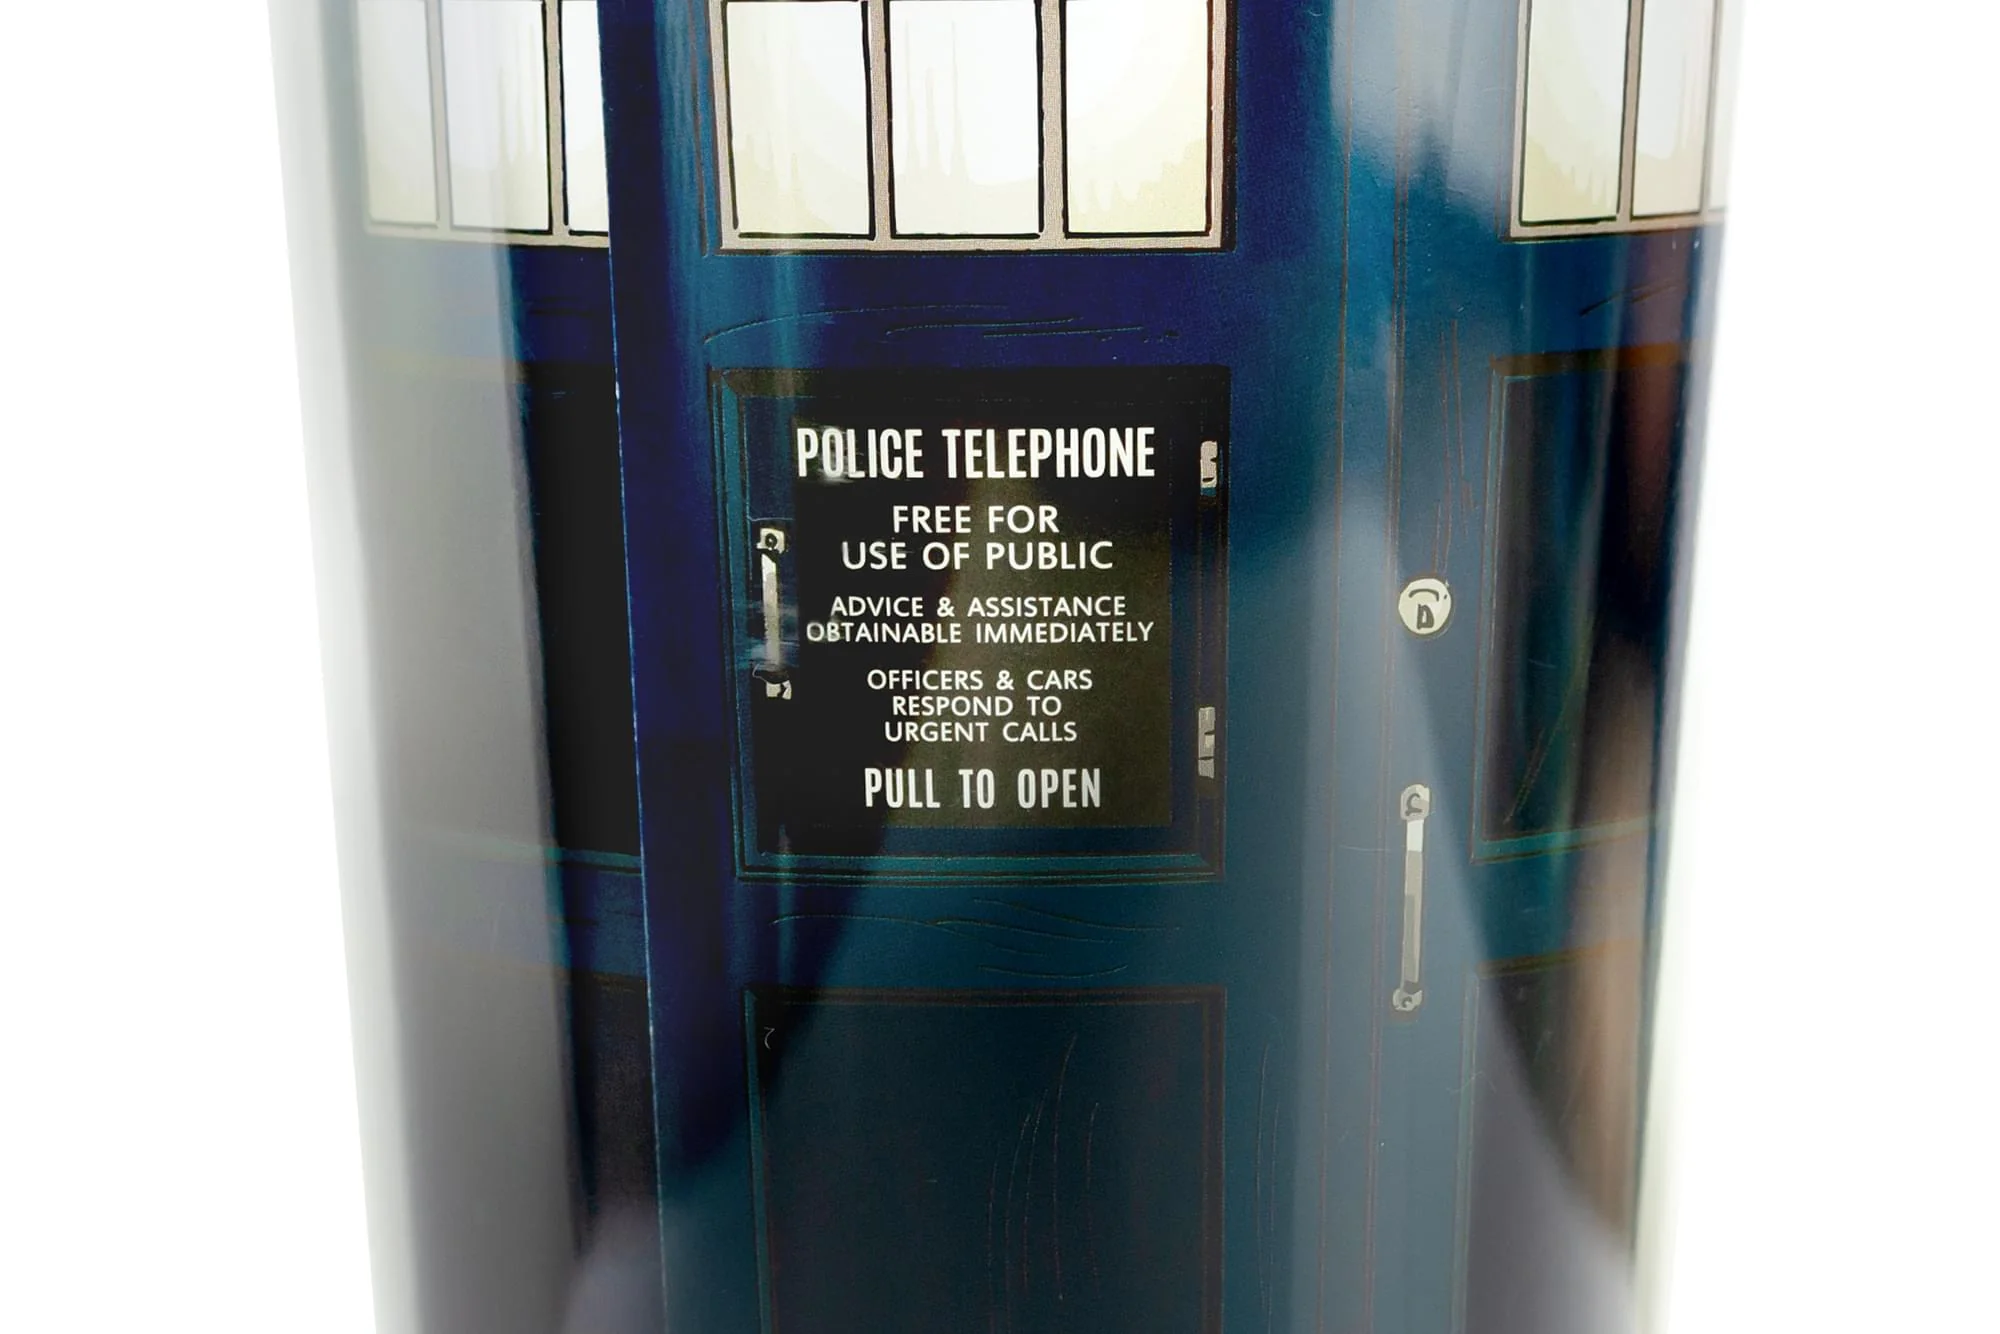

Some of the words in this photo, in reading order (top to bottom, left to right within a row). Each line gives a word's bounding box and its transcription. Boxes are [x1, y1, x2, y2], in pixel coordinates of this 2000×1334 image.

[796, 426, 924, 479] POLICE
[941, 426, 1155, 479] TELEPHONE
[892, 505, 972, 534] FREE
[987, 504, 1060, 534] FOR
[842, 541, 907, 570] USE
[922, 541, 970, 571] OF
[985, 540, 1113, 571] PUBLIC
[830, 595, 924, 618] ADVICE
[936, 596, 956, 618] &
[966, 595, 1126, 618] ASSISTANCE
[806, 620, 962, 644] OBTAINABLE
[975, 621, 1154, 644] IMMEDIATELY
[867, 669, 984, 691] OFFICERS
[995, 669, 1015, 691] &
[1026, 668, 1093, 691] CARS
[892, 695, 1014, 717] RESPOND
[1025, 695, 1062, 717] TO
[884, 720, 990, 743] URGENT
[1002, 721, 1078, 743] CALLS
[864, 767, 941, 809] PULL
[957, 768, 996, 809] TO
[1017, 767, 1100, 809] OPEN
